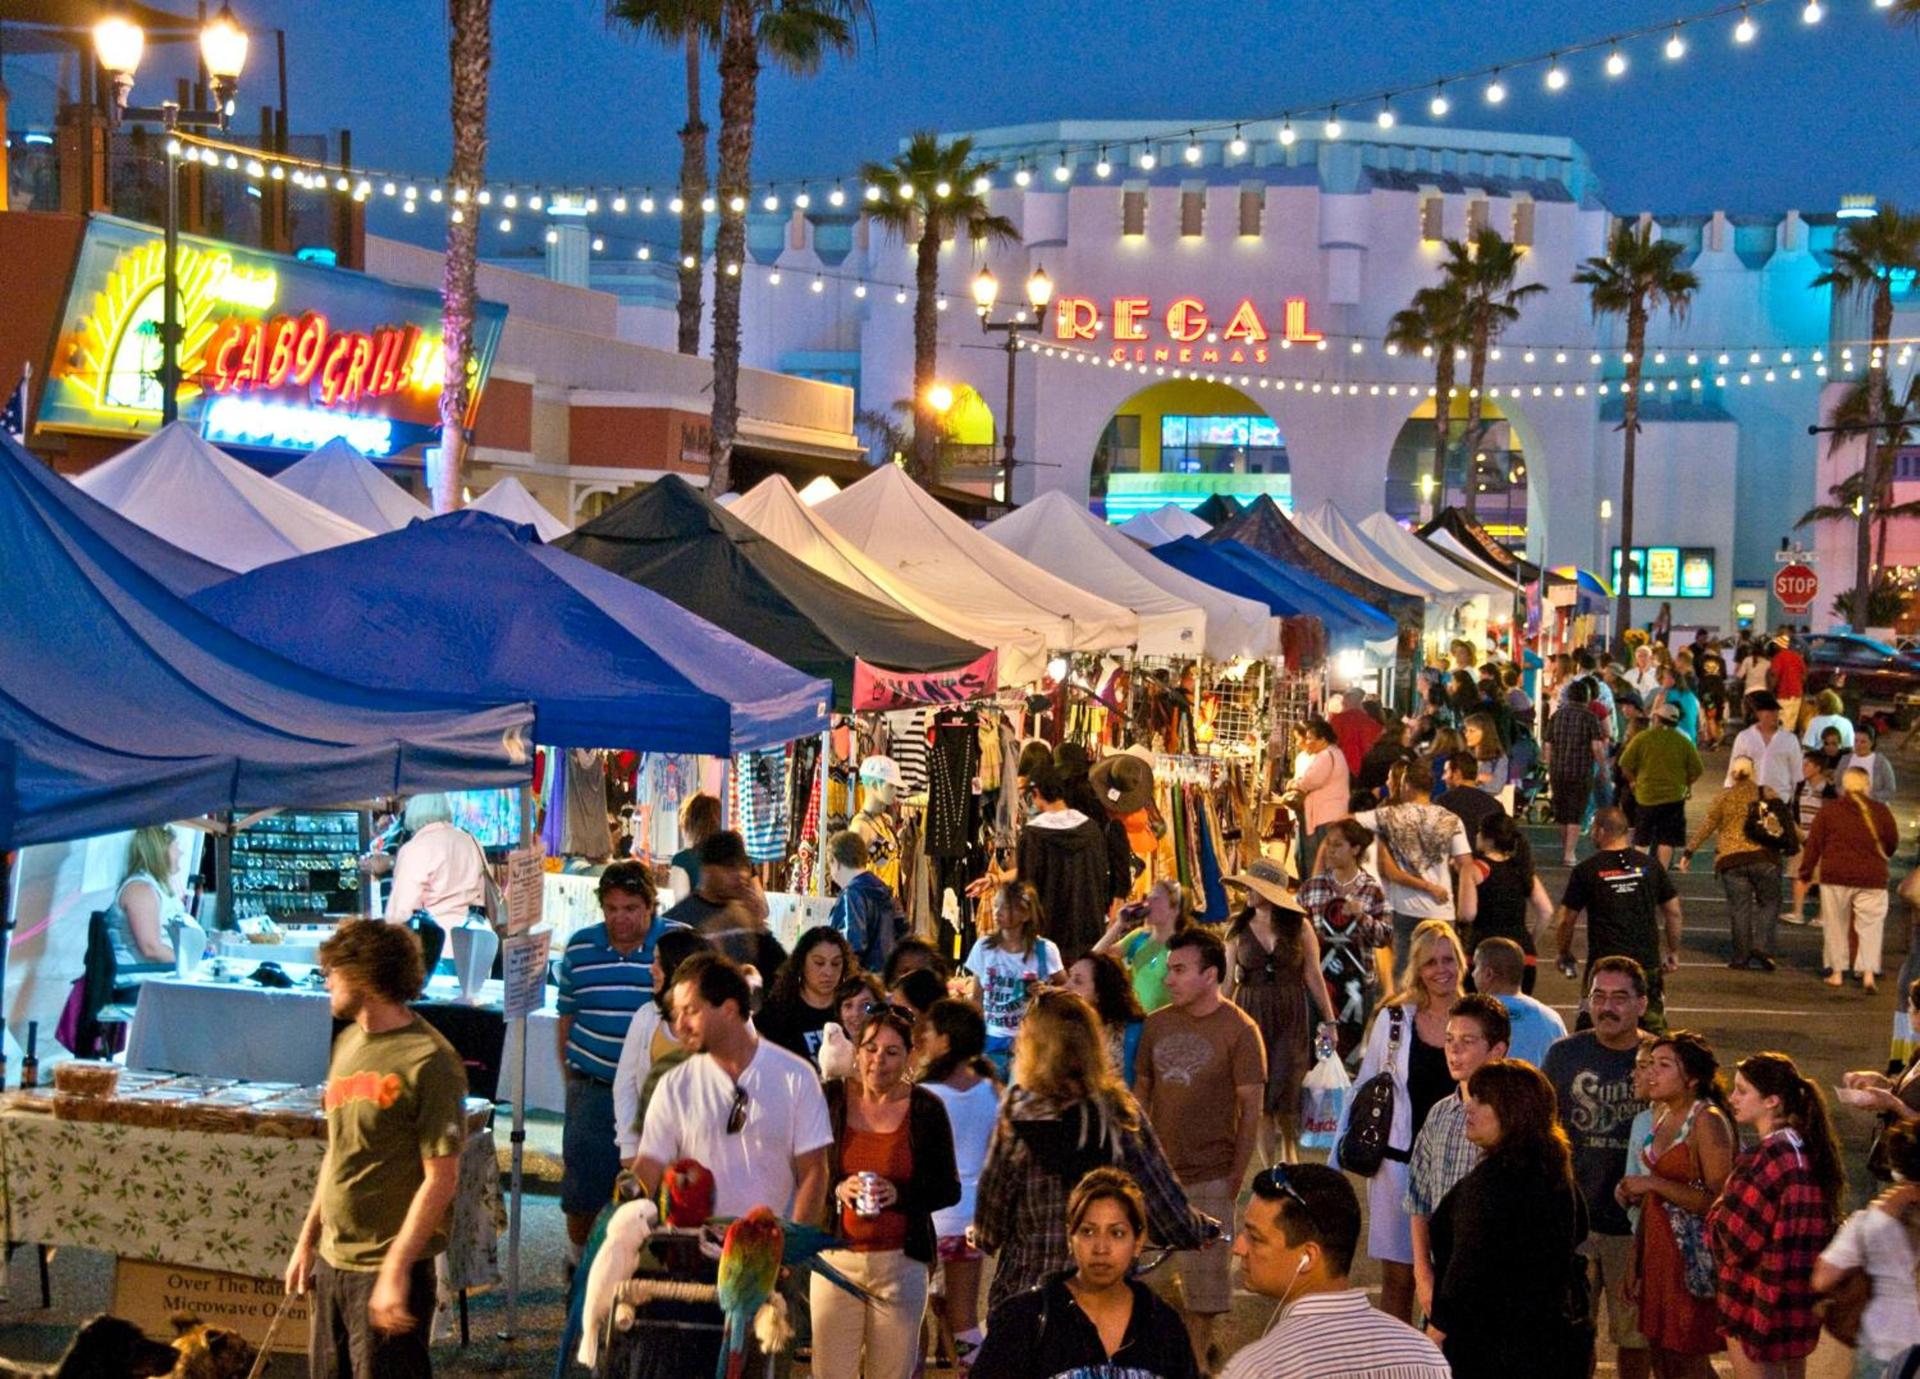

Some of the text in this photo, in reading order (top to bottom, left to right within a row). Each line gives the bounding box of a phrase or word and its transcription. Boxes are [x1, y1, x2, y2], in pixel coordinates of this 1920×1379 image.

[1055, 297, 1325, 343] REGAL
[204, 313, 330, 395] CABO
[1110, 347, 1270, 363] CINEMAS
[1776, 577, 1817, 594] STOP
[167, 1273, 211, 1290] Over
[216, 1277, 249, 1294] The
[163, 1295, 258, 1318] Microwave
